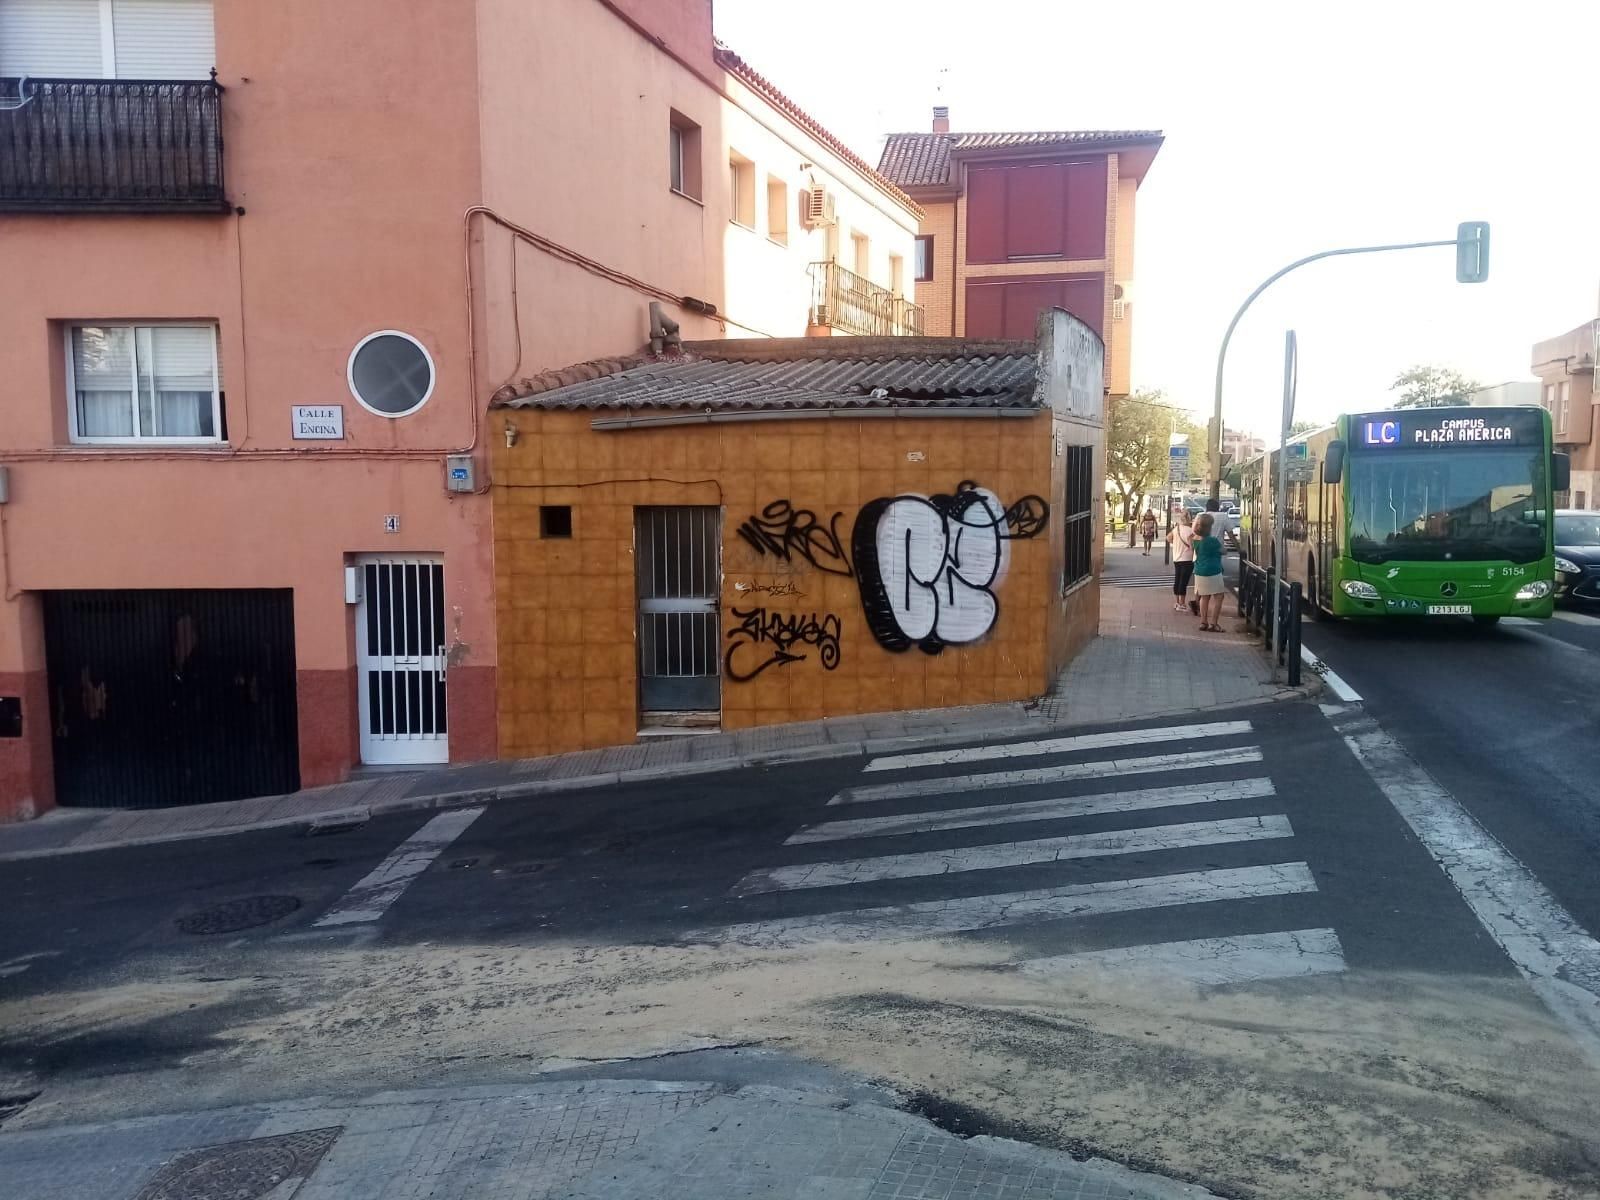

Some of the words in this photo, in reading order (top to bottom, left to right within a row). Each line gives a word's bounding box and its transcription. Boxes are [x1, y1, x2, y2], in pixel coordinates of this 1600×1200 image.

[299, 407, 335, 418] CALLE
[299, 422, 337, 434] ENCINA
[1442, 418, 1485, 430] CAMPUS
[1367, 421, 1395, 444] LC
[1415, 429, 1454, 442] PLAZA
[388, 518, 395, 529] 4
[1502, 567, 1525, 576] 5154
